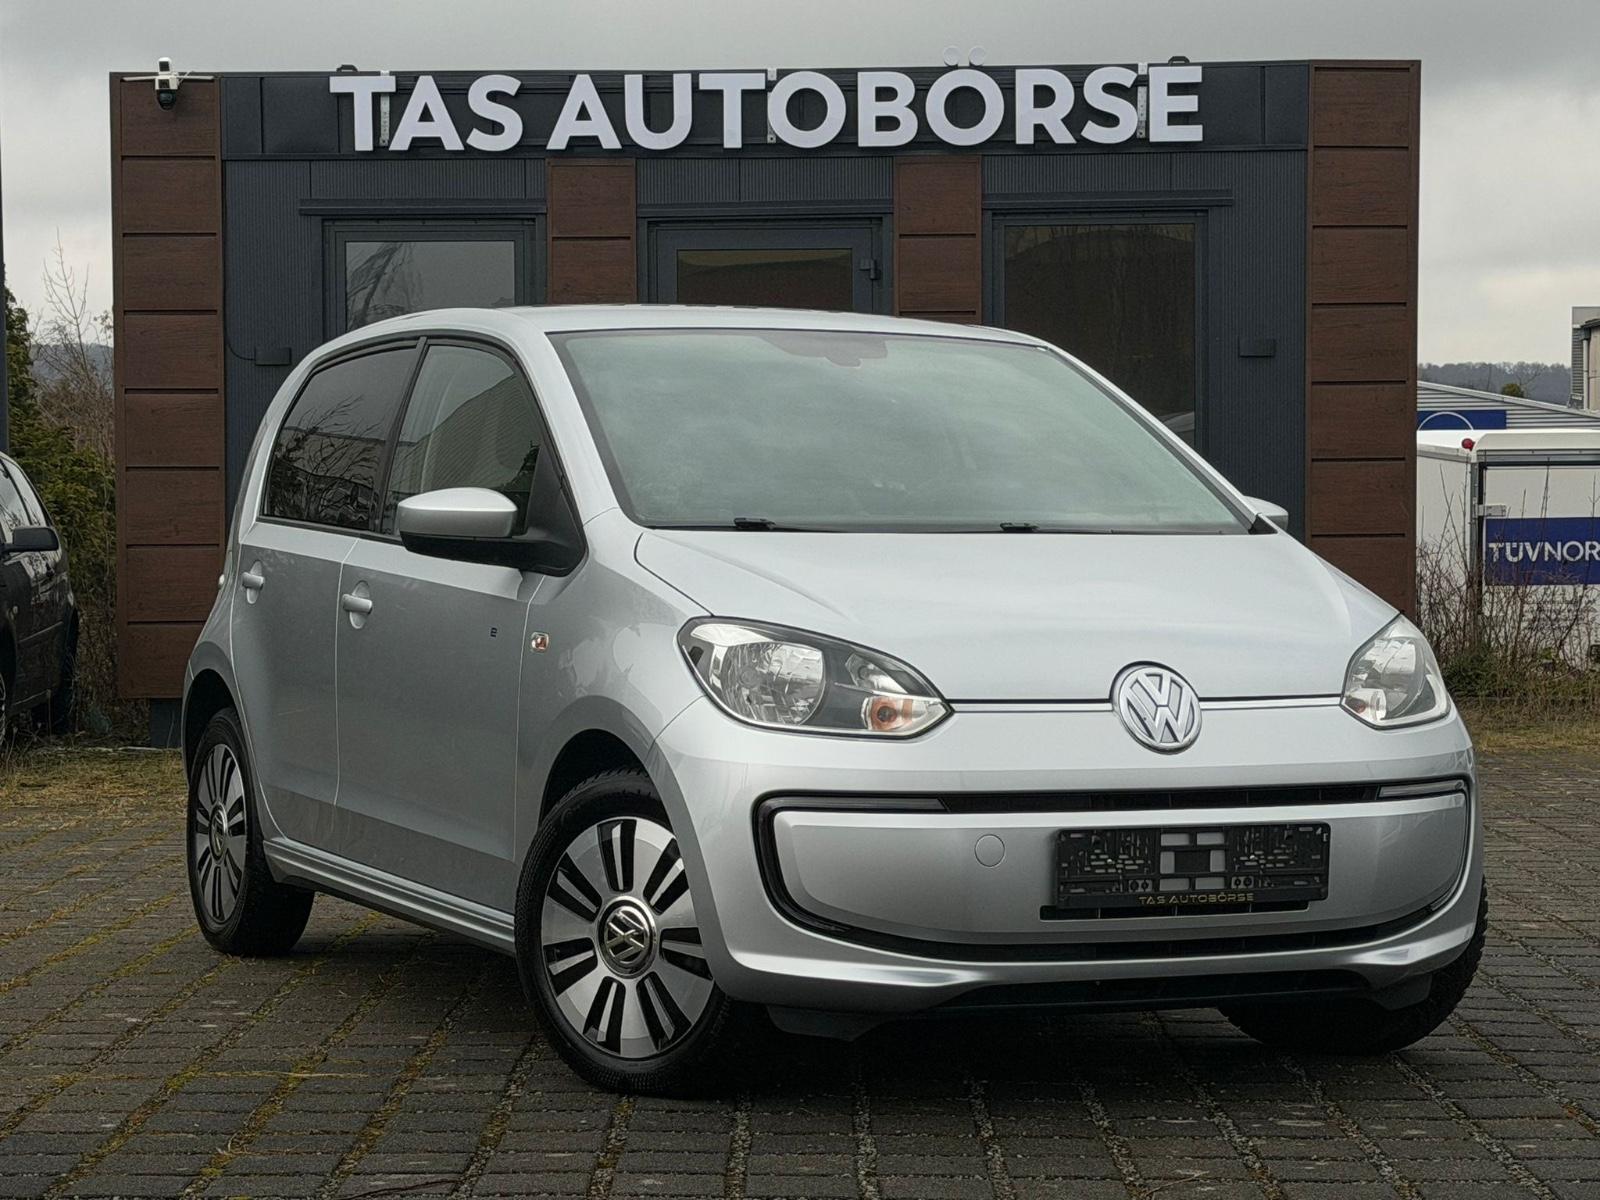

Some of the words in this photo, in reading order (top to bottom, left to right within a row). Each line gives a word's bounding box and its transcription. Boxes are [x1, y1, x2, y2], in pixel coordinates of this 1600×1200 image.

[329, 73, 524, 152] TAS
[545, 45, 1204, 150] AUTOBÖRSE
[1116, 664, 1198, 748] VW
[1138, 895, 1166, 905] TAS
[1168, 891, 1255, 904] AUTOBÖRSE
